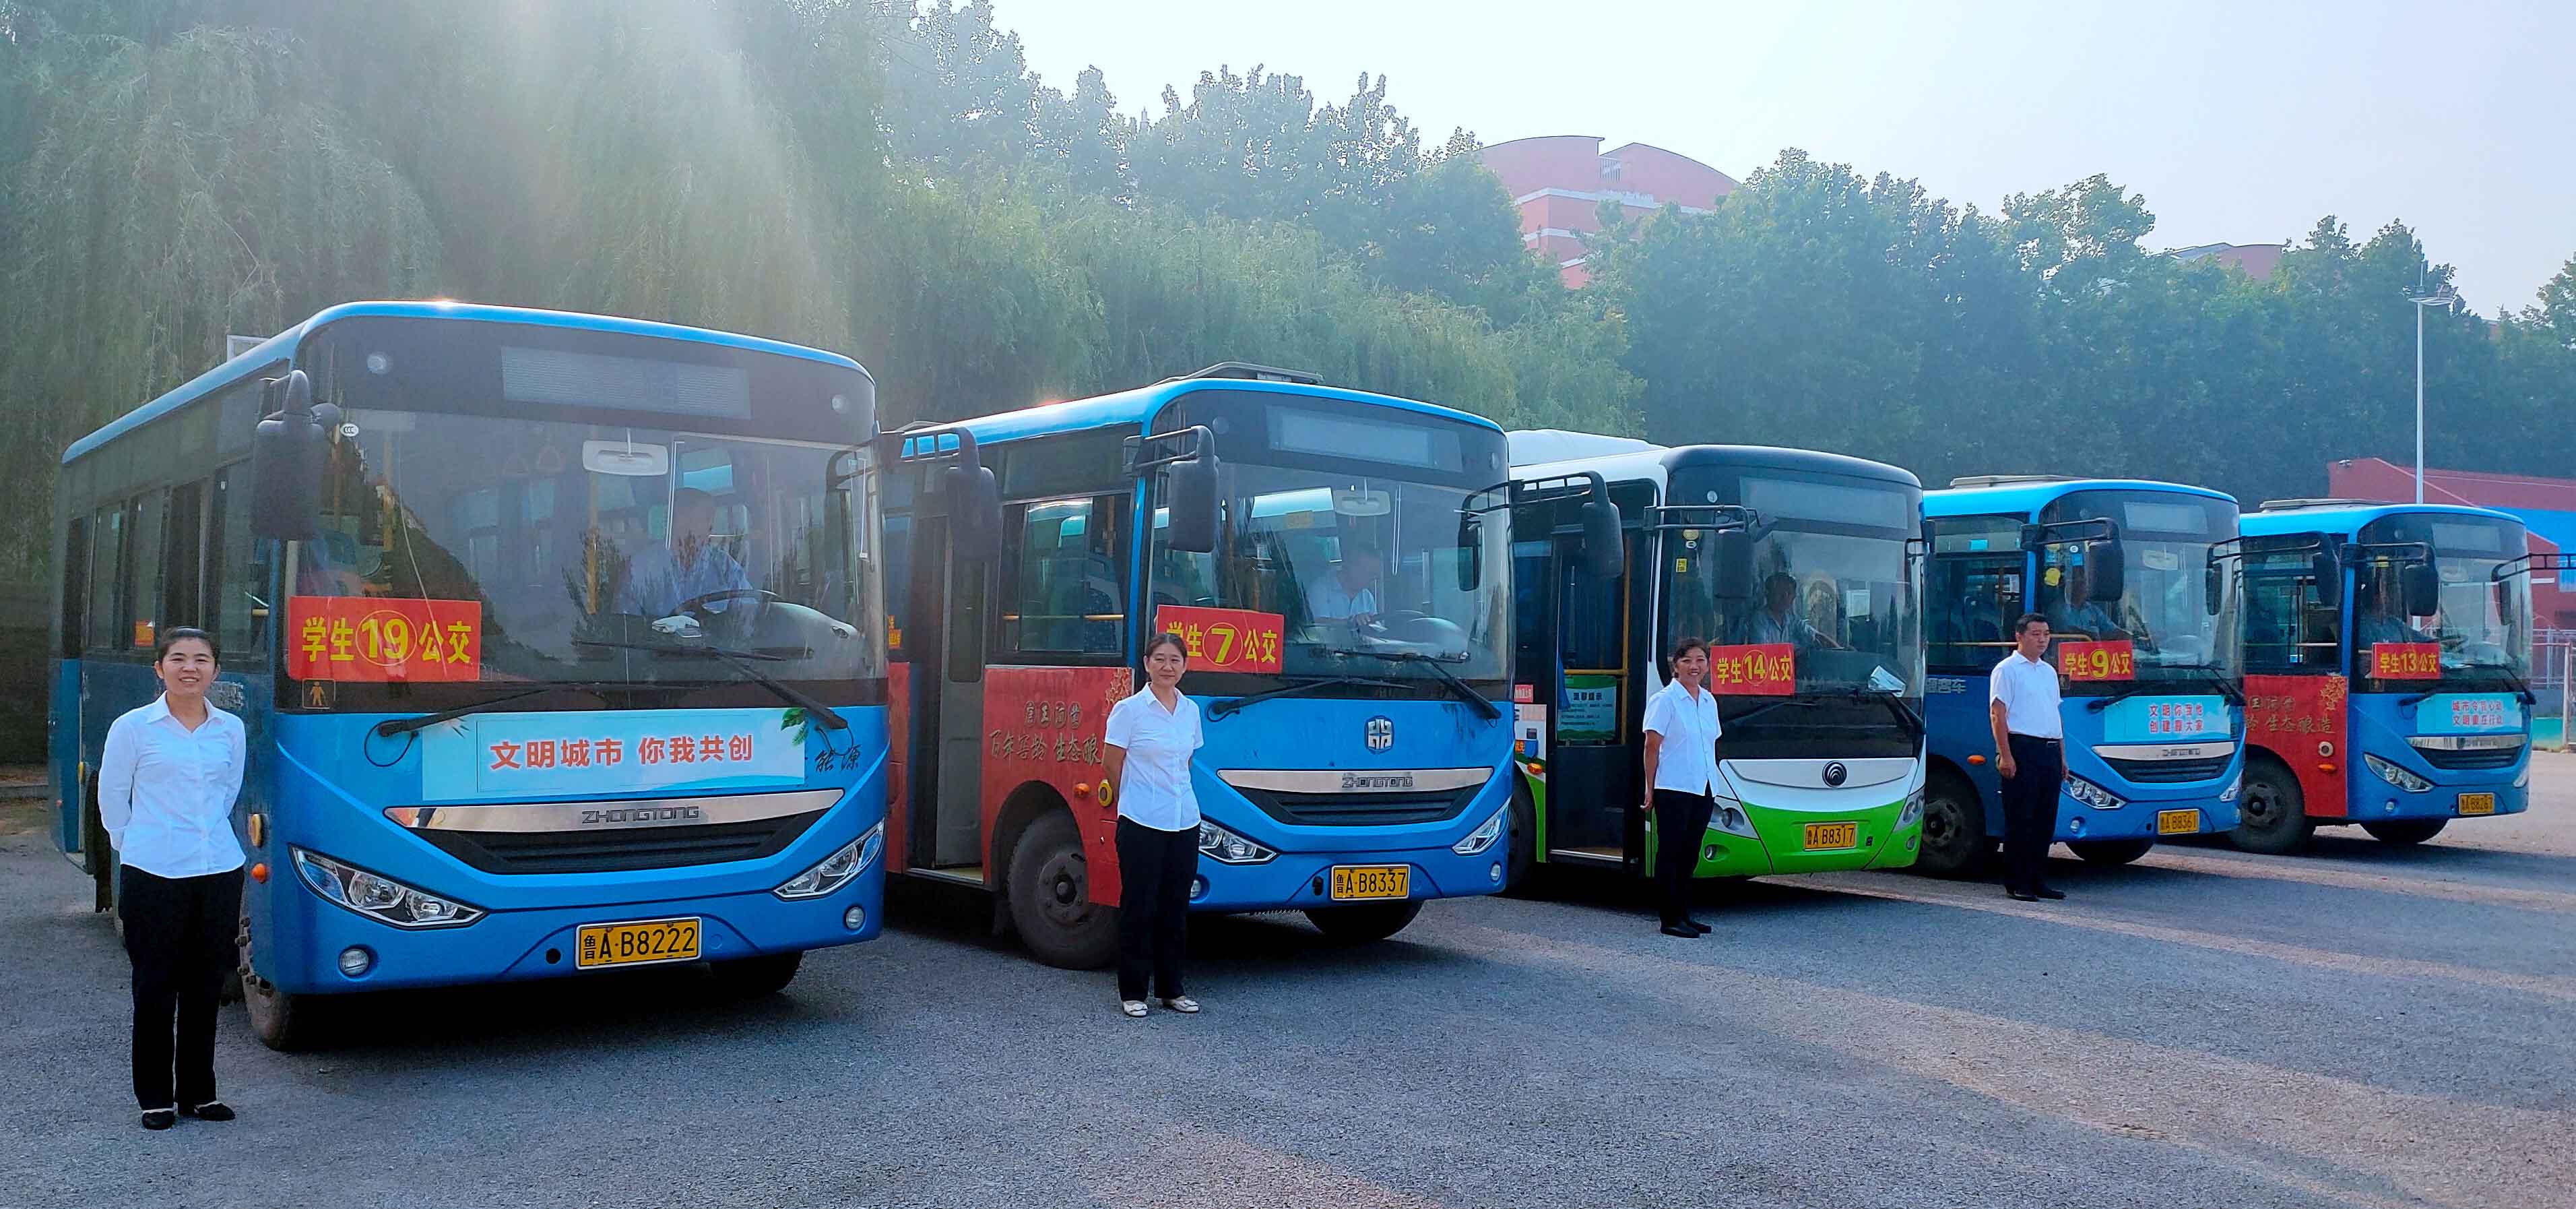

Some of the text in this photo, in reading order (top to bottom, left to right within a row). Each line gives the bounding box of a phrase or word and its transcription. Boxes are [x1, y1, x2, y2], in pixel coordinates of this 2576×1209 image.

[489, 734, 754, 770] 文明城市 你我共创
[1341, 776, 1413, 788] ZHONGTONG
[581, 805, 699, 824] ZHONGTONG
